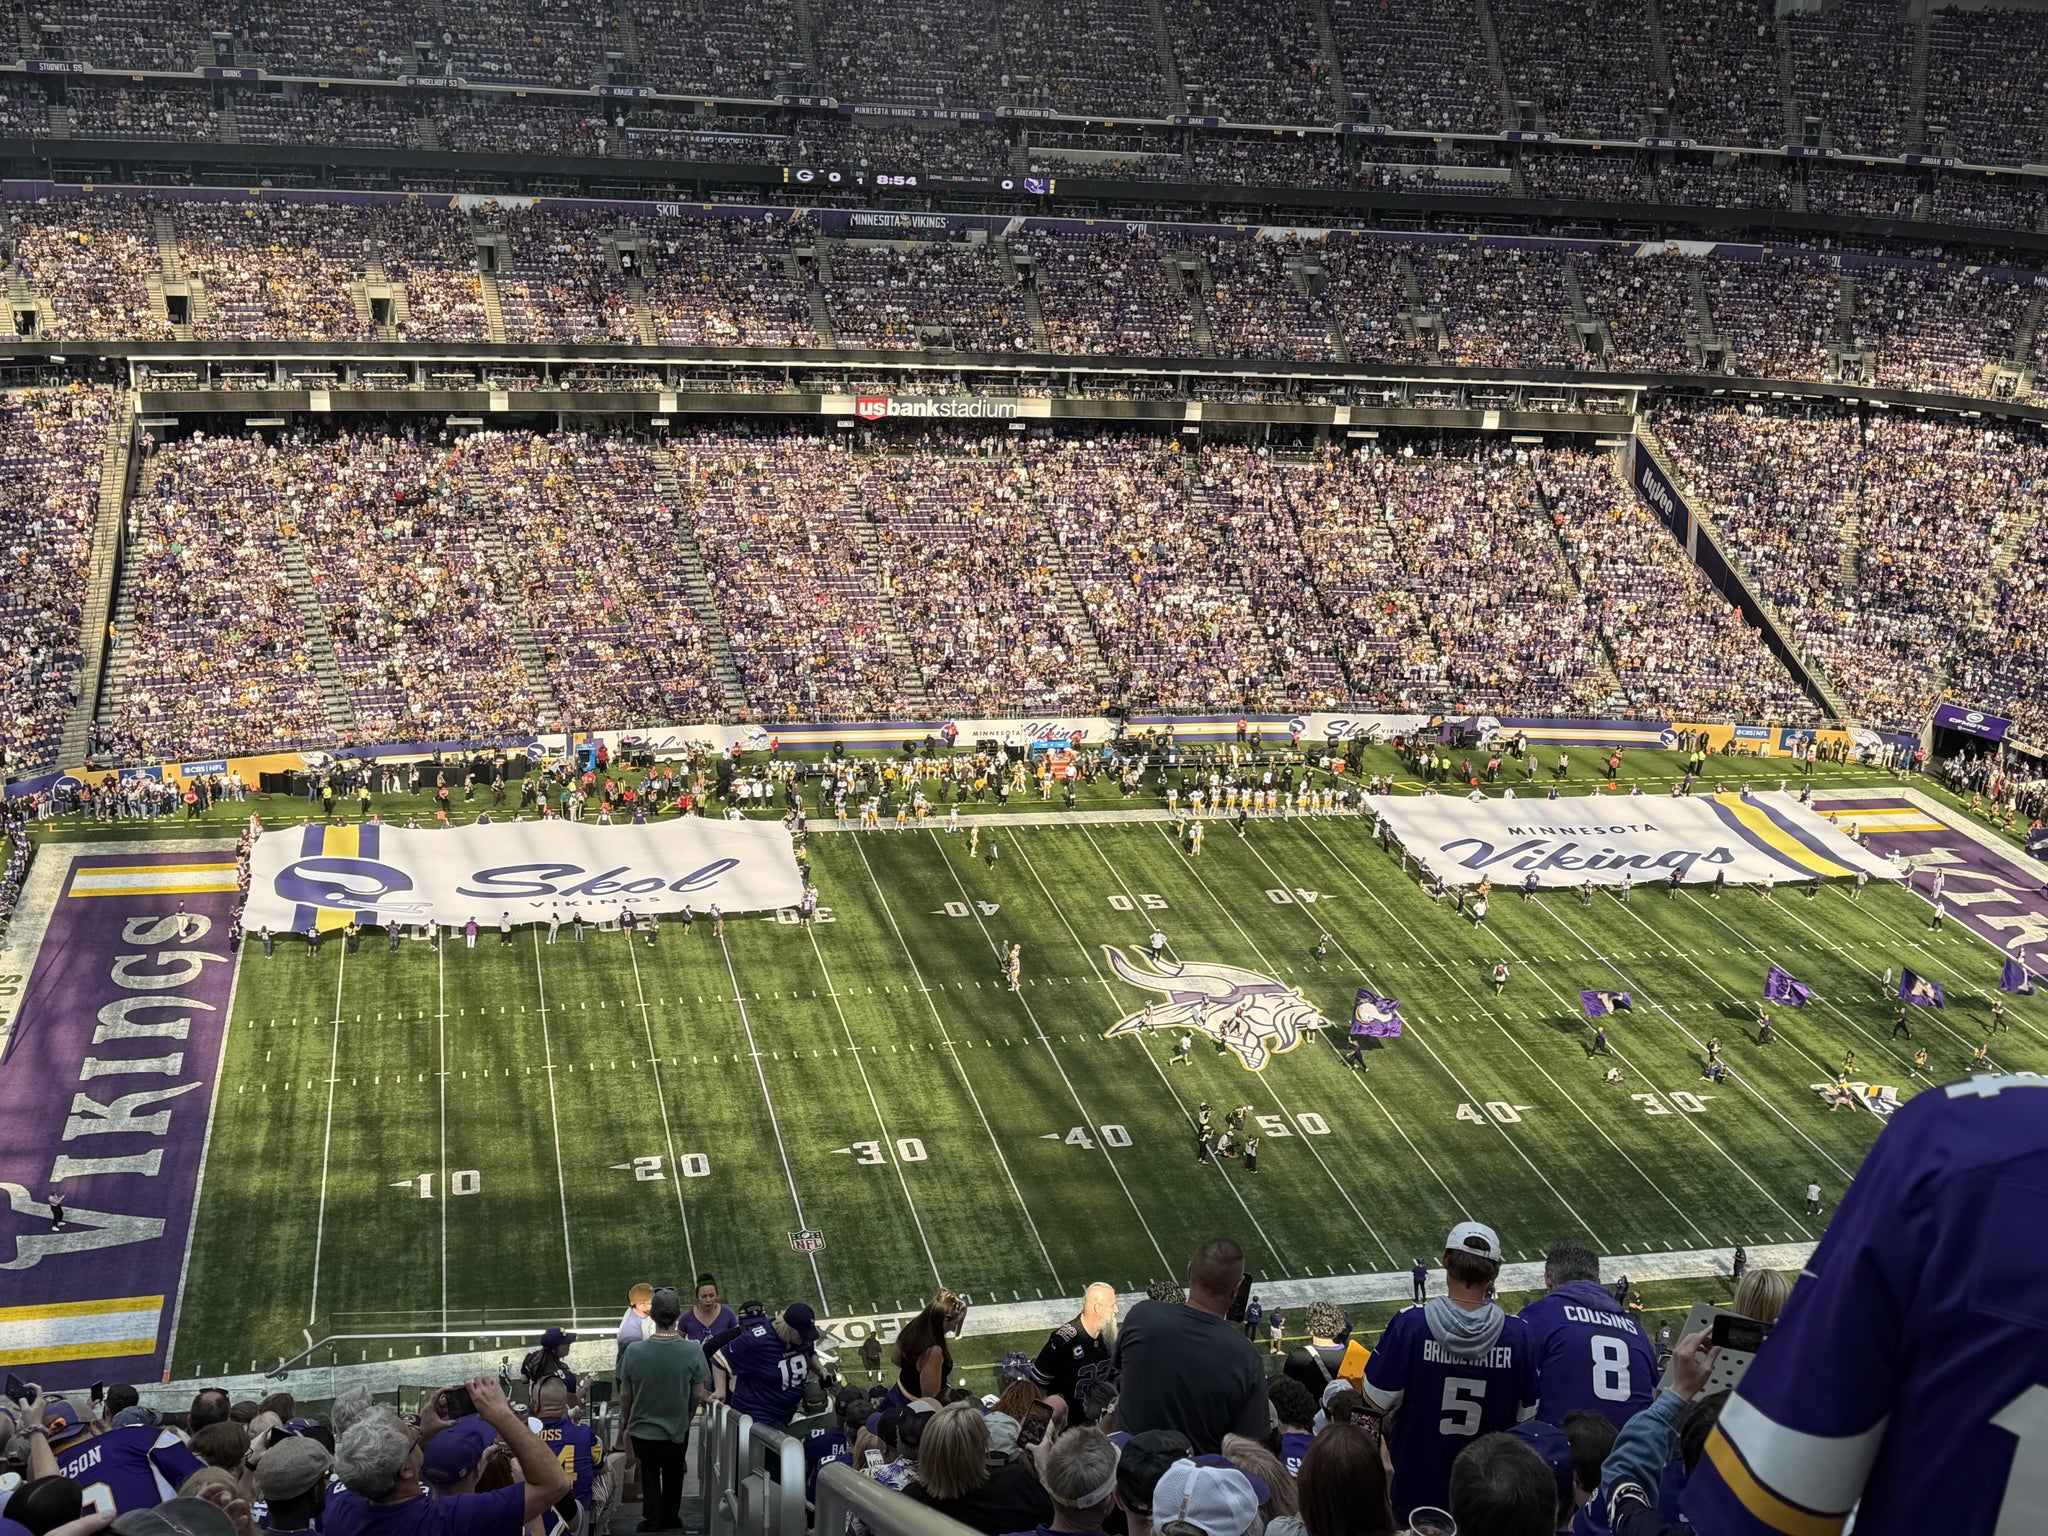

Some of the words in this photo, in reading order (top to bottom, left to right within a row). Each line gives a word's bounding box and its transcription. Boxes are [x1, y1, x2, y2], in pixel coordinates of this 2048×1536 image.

[39, 63, 70, 72] STUDWELL
[222, 69, 242, 78] BURNS
[416, 77, 448, 86] TINGELHOFF
[448, 78, 458, 87] 53
[613, 88, 634, 97] KRAUSE
[639, 88, 648, 97] 22
[798, 98, 812, 106] PAGE
[854, 106, 889, 115] MINNESOTA
[891, 108, 916, 118] VIKINGS
[933, 110, 948, 118] RING
[950, 111, 958, 119] OF
[960, 112, 980, 120] HONOR
[1014, 108, 1042, 117] TARKENTON
[1188, 117, 1204, 125] GRANT
[1352, 125, 1375, 134] STRINGER
[1376, 126, 1385, 134] 77
[1520, 131, 1538, 141] BROWN
[1543, 132, 1552, 142] 30
[1658, 140, 1677, 148] RANDLE
[1803, 147, 1819, 156] BLAIR
[1920, 156, 1941, 166] JORDAN
[828, 171, 842, 183] 0
[856, 177, 864, 185] 1
[876, 174, 918, 186] 8:54
[1001, 179, 1014, 190] 0
[656, 204, 682, 218] SKOL
[850, 213, 901, 228] MINNESOTA
[911, 216, 947, 229] VIKINGS
[1948, 717, 1992, 732] CFMOTO
[209, 764, 225, 772] NFL
[1507, 823, 1659, 836] MINNESOTA
[1440, 838, 1736, 878] Vikings
[456, 858, 740, 899] Skol
[529, 896, 661, 908] VIKINGS
[1108, 894, 1169, 911] 50
[944, 901, 1001, 917] 40
[1631, 1091, 1707, 1116] 30
[1456, 1101, 1522, 1125] 40
[1255, 1112, 1332, 1138] 50
[1064, 1124, 1134, 1151] 40
[852, 1138, 928, 1165] 30
[633, 1153, 712, 1182] 20
[416, 1169, 481, 1199] 10
[795, 1239, 832, 1250] NFL
[1563, 1305, 1638, 1336] COUSINS
[1590, 1335, 1632, 1402] 8
[1439, 1376, 1488, 1437] 5
[538, 1429, 562, 1442] OSS
